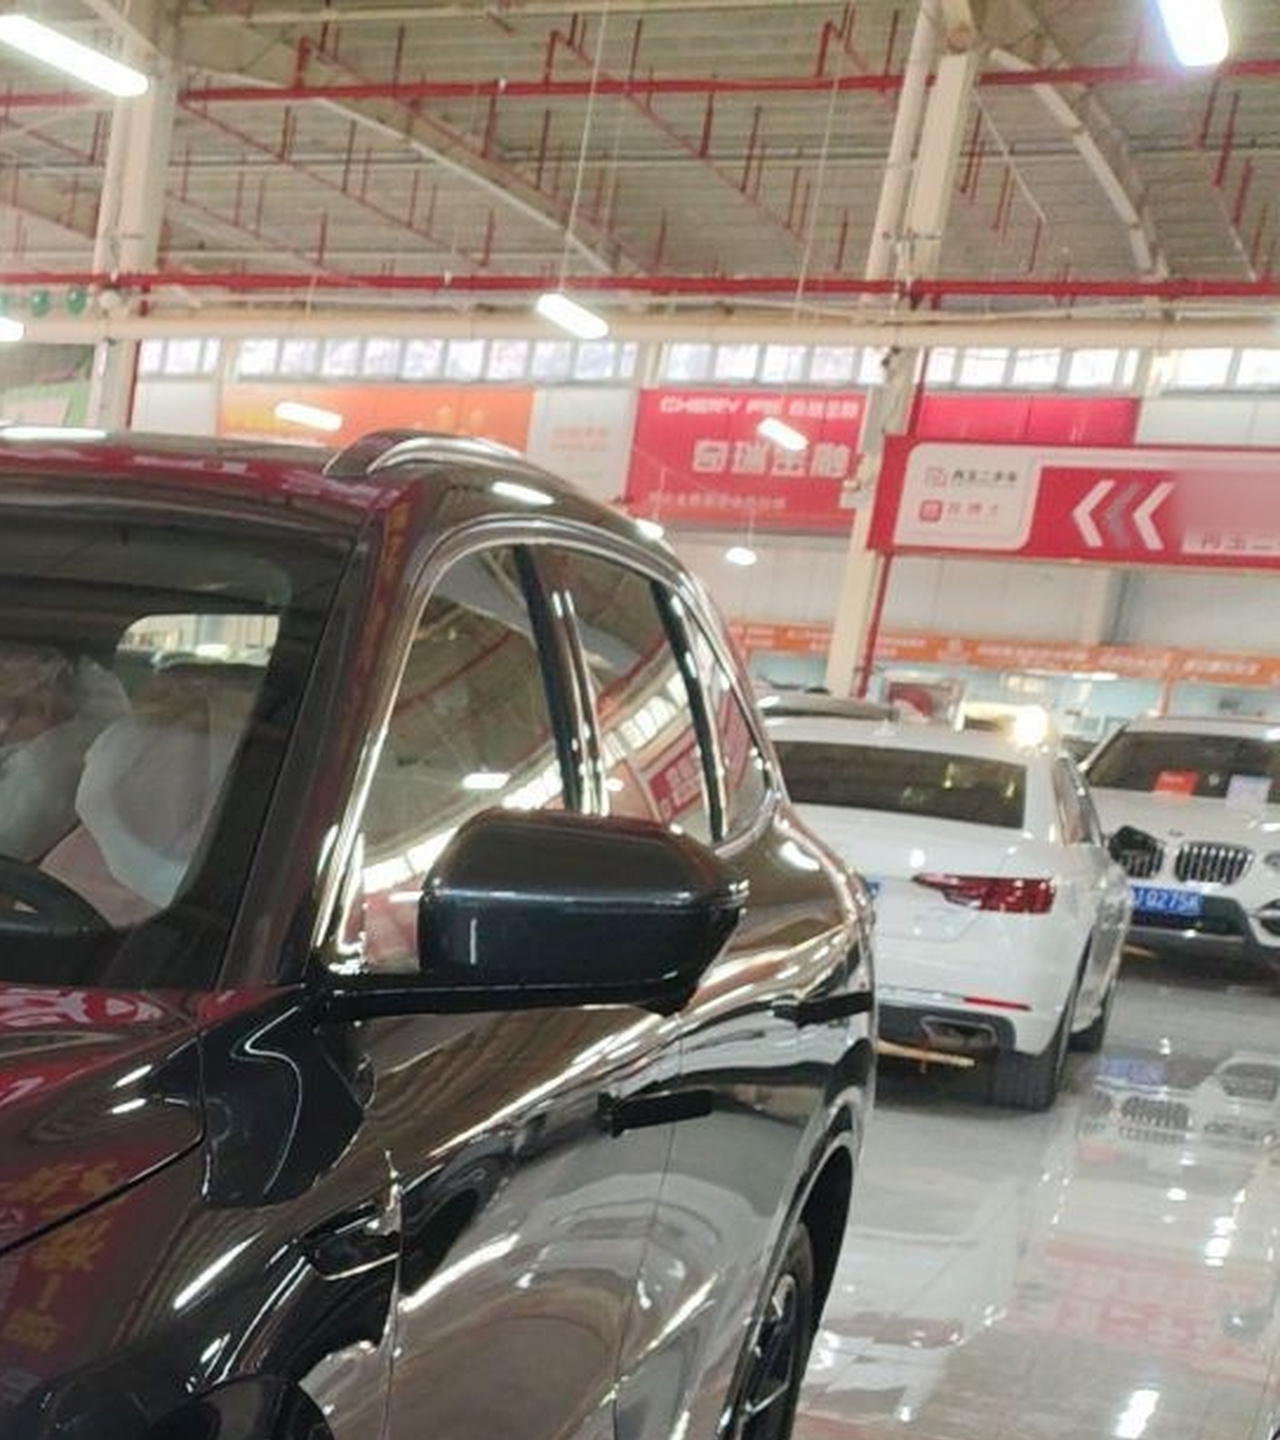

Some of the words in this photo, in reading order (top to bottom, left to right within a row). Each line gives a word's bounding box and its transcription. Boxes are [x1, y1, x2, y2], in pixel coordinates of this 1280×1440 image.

[661, 395, 742, 414] CHERY
[692, 438, 851, 478] 奇瑞金融
